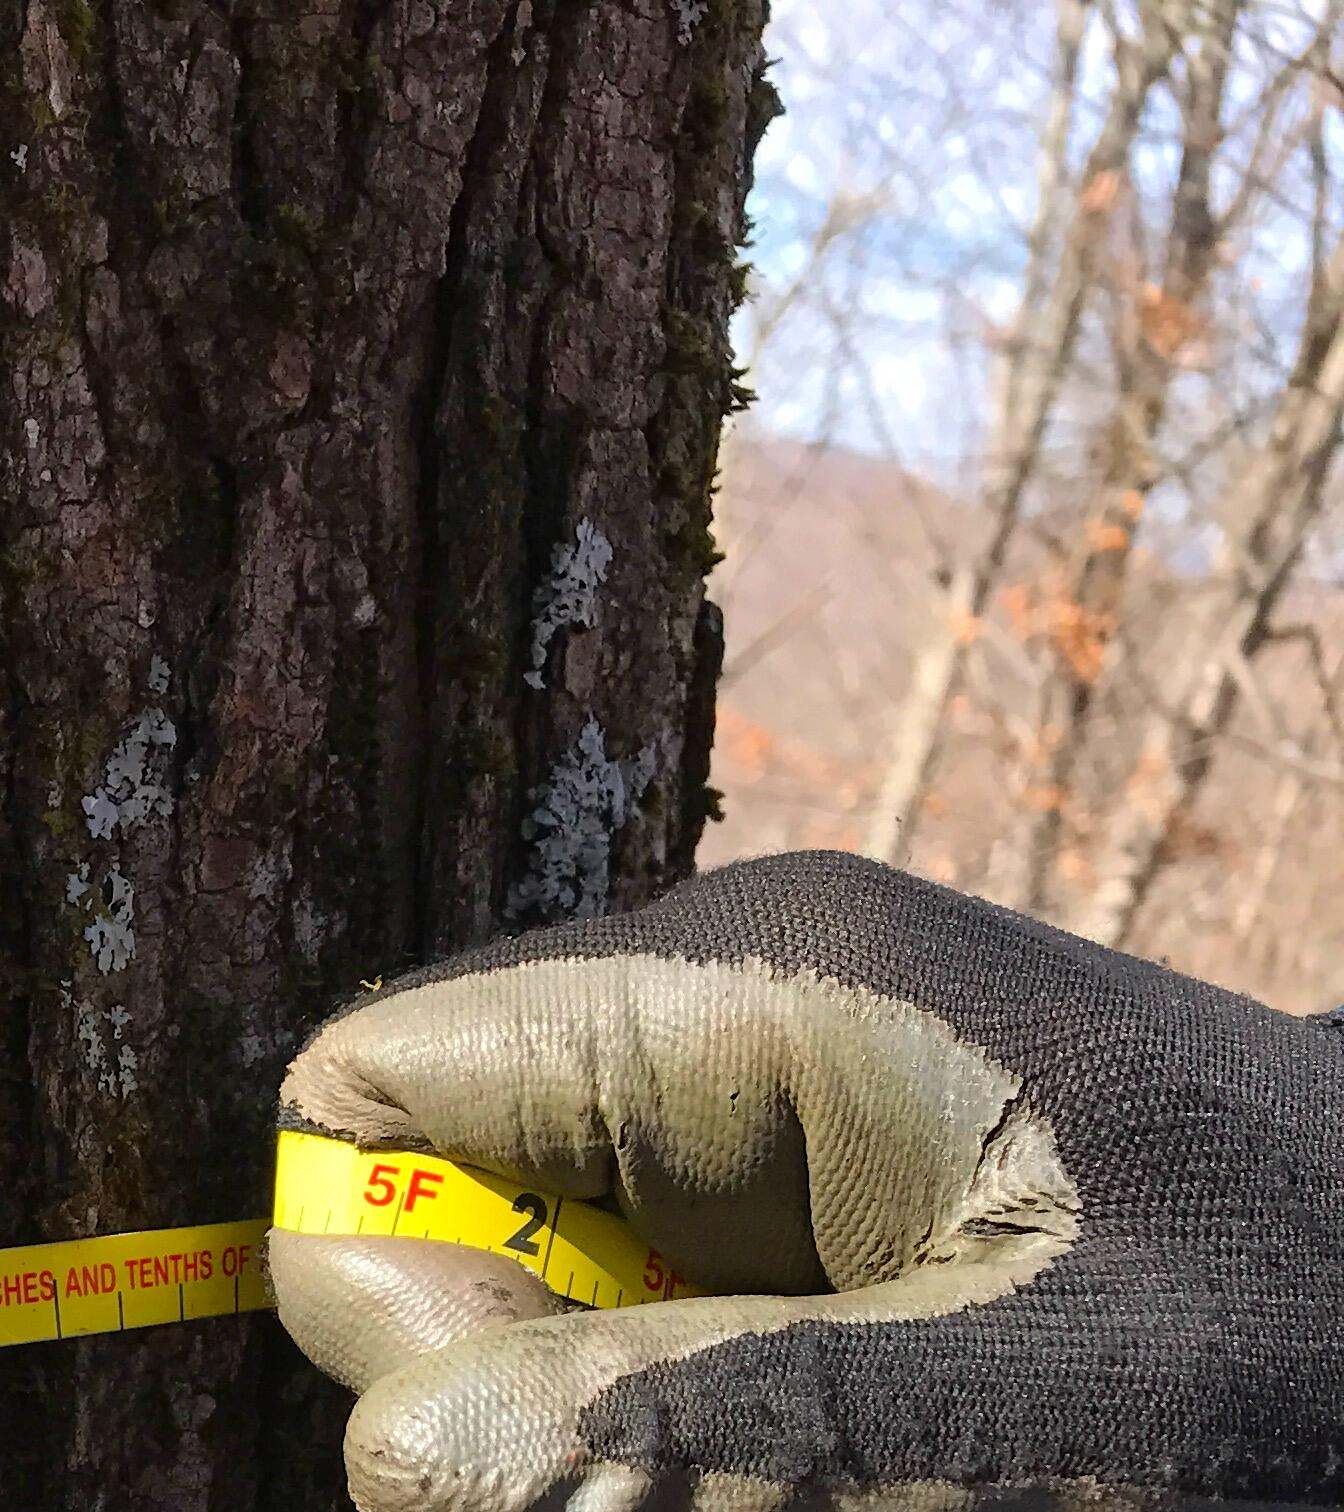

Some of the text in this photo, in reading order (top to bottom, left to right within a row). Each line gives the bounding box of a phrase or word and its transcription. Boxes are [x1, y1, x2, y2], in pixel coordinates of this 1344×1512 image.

[364, 1165, 444, 1212] 5F
[503, 1193, 548, 1256] 2
[65, 1263, 116, 1298] AND
[125, 1251, 212, 1290] TENTHS
[222, 1245, 251, 1276] OF
